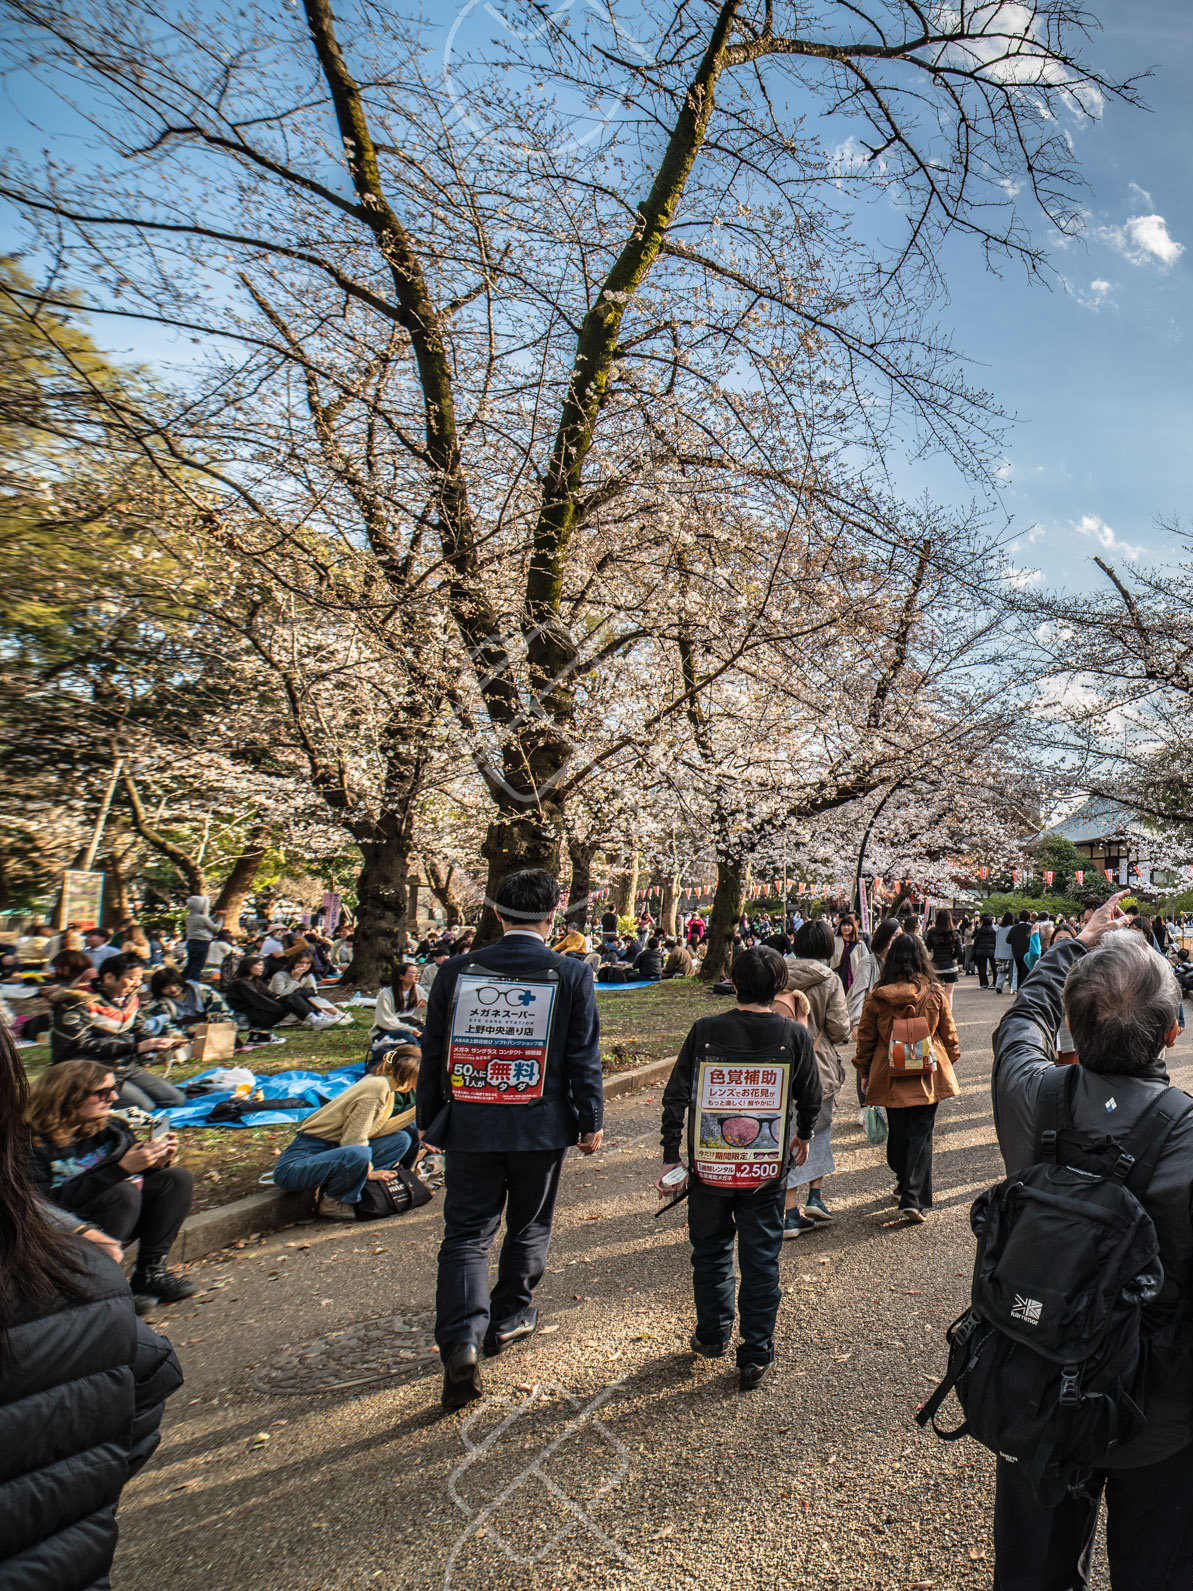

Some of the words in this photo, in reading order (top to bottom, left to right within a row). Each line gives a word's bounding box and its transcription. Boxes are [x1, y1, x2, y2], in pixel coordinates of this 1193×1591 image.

[469, 1008, 535, 1019] メガネスーパー
[465, 1024, 534, 1036] 上野中央通り店
[471, 1047, 497, 1055] サングラス
[453, 1063, 486, 1077] 50人に
[489, 1061, 535, 1081] 無料
[464, 1076, 485, 1088] 1人が
[710, 1069, 777, 1085] 色覚補助
[709, 1088, 775, 1097] レンズでお花見が
